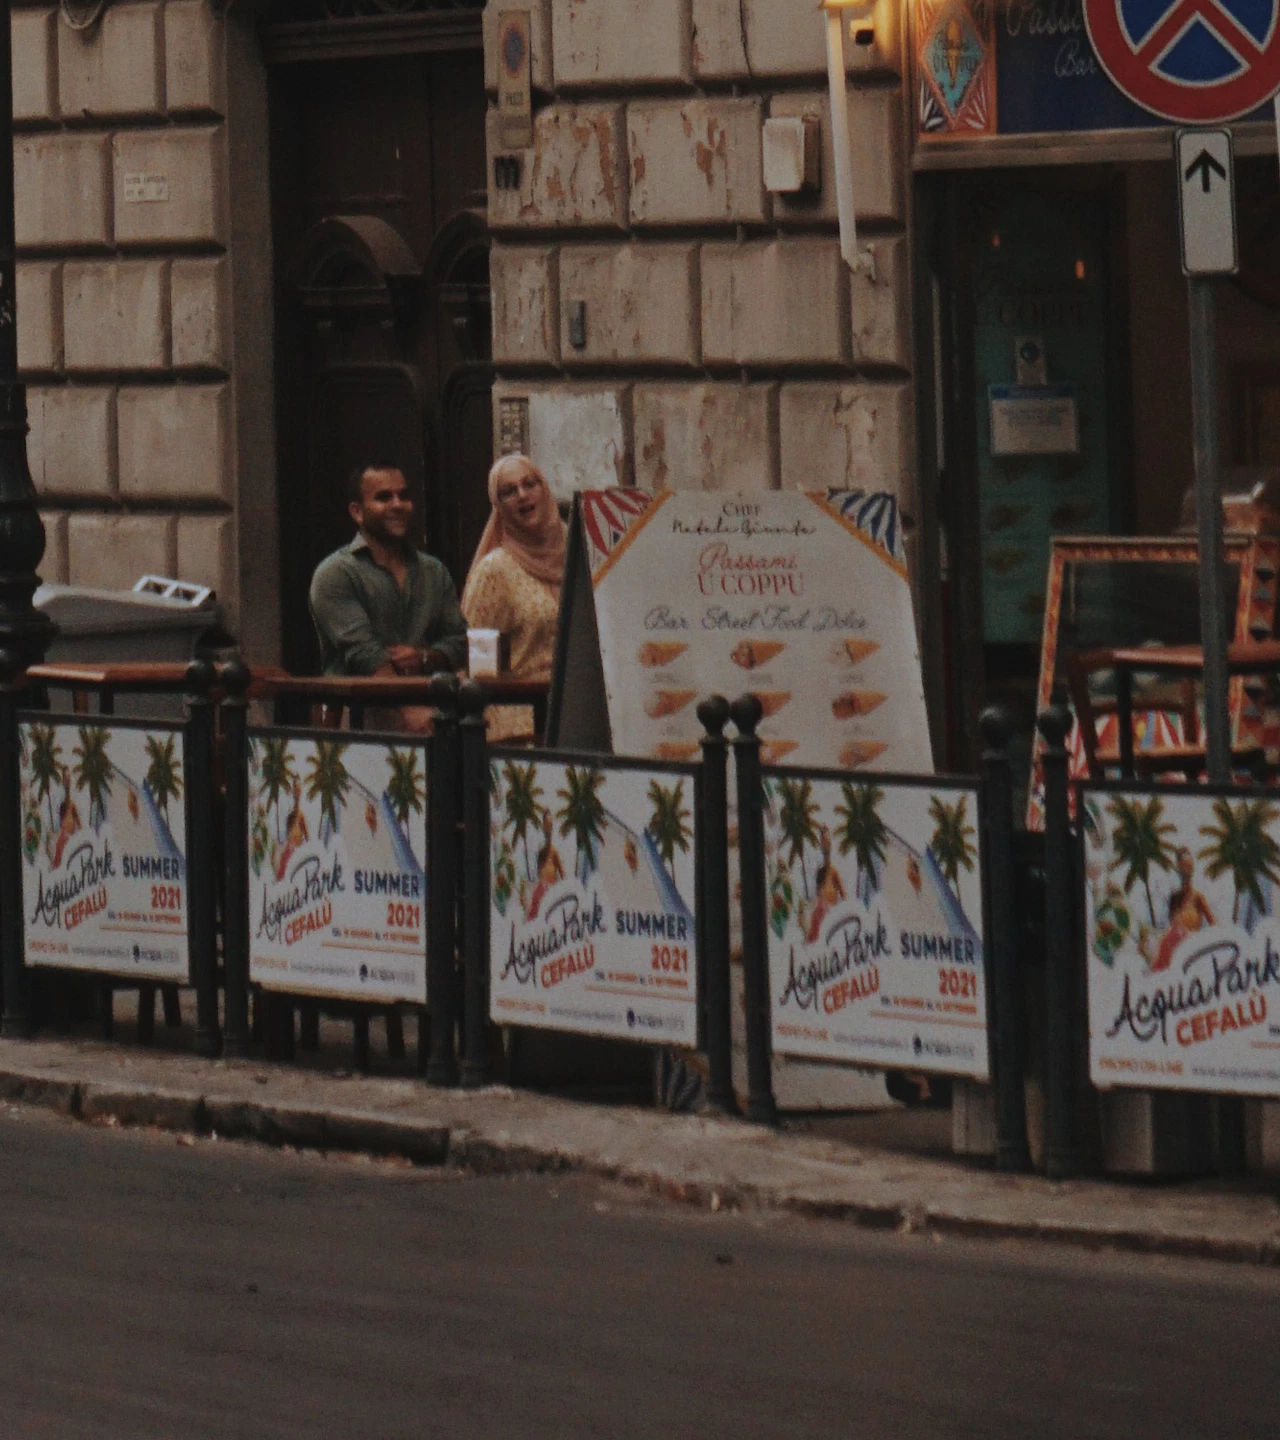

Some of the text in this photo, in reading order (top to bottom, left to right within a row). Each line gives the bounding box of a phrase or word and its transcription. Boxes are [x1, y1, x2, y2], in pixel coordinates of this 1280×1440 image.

[700, 542, 798, 572] Passami
[721, 573, 803, 596] COPPU
[644, 604, 690, 630] Bar
[701, 605, 761, 631] Street
[762, 604, 810, 631] Food
[122, 852, 180, 880] SUMMER
[151, 885, 181, 909] 2021
[354, 870, 420, 897] SUMMER
[387, 903, 420, 928] 2021
[616, 910, 687, 940] SUMMER
[652, 944, 688, 972] 2021
[900, 931, 975, 964] SUMMER
[541, 937, 595, 989] CEFALÙ
[939, 968, 977, 997] 2021
[1176, 988, 1266, 1047] CEFALÙ
